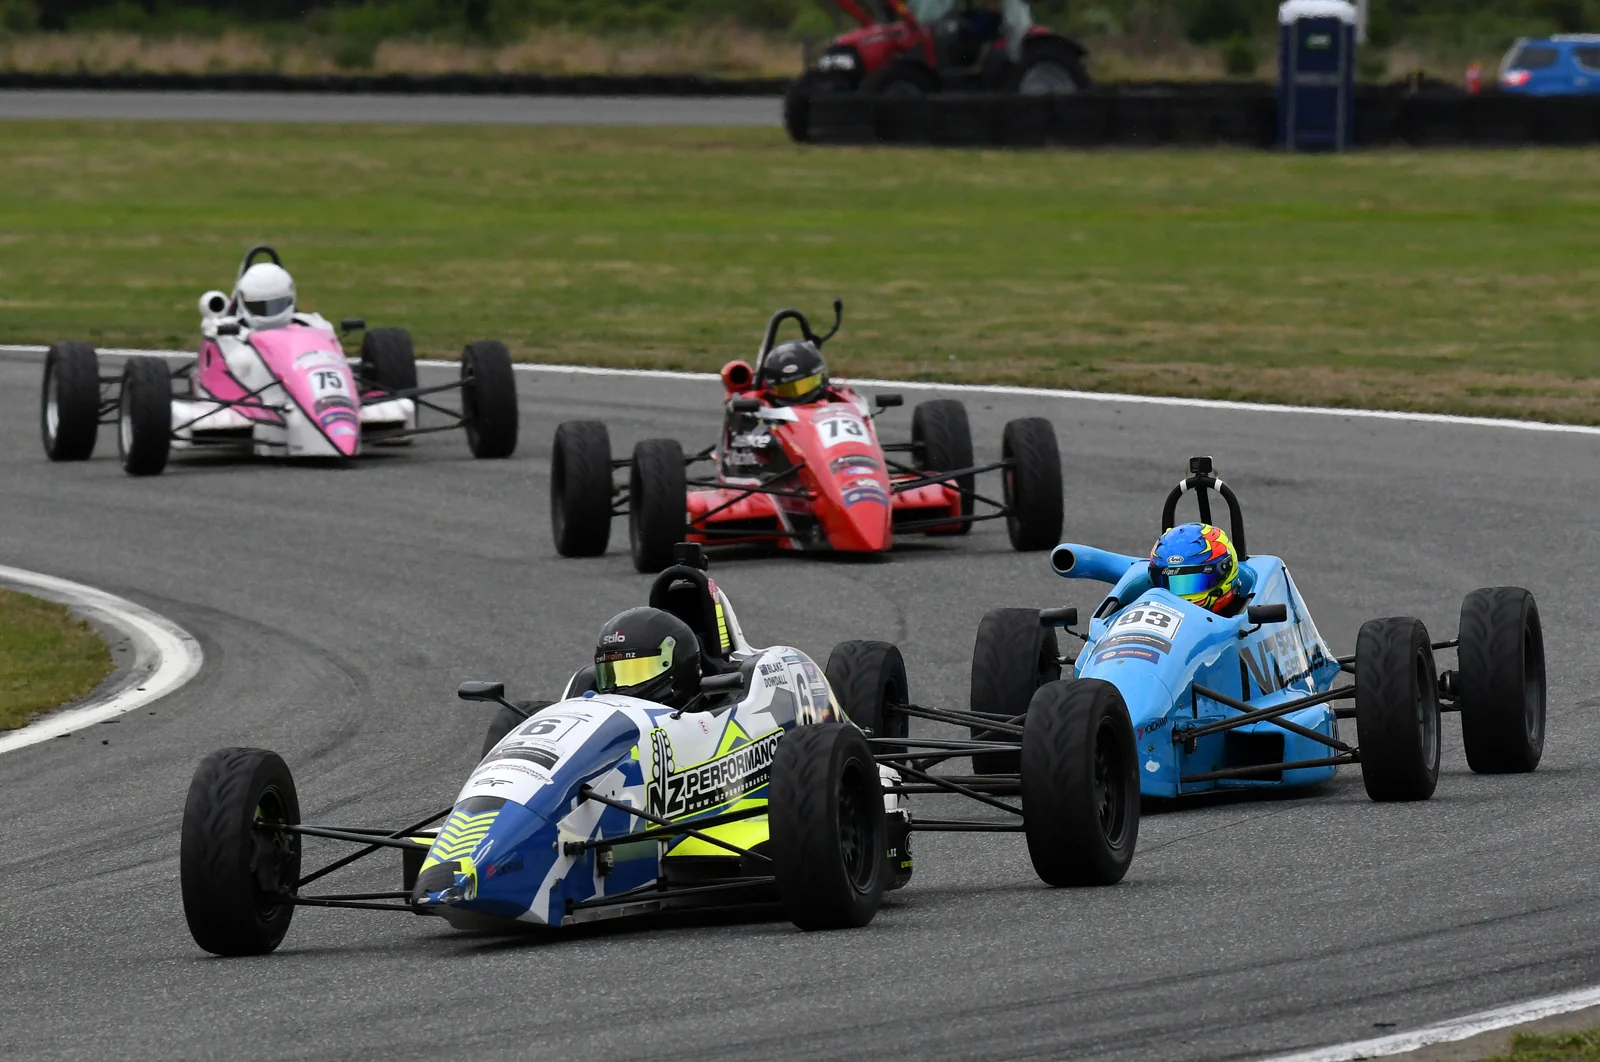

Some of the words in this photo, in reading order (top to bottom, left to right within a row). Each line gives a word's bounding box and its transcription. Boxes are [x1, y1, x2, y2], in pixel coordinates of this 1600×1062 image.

[313, 371, 343, 389] 75
[822, 419, 863, 438] 73
[1118, 610, 1172, 628] 93
[766, 662, 784, 673] BLAKE
[764, 675, 788, 688] DOWDALL
[519, 719, 561, 735] 6
[684, 732, 784, 802] PERFORMANC
